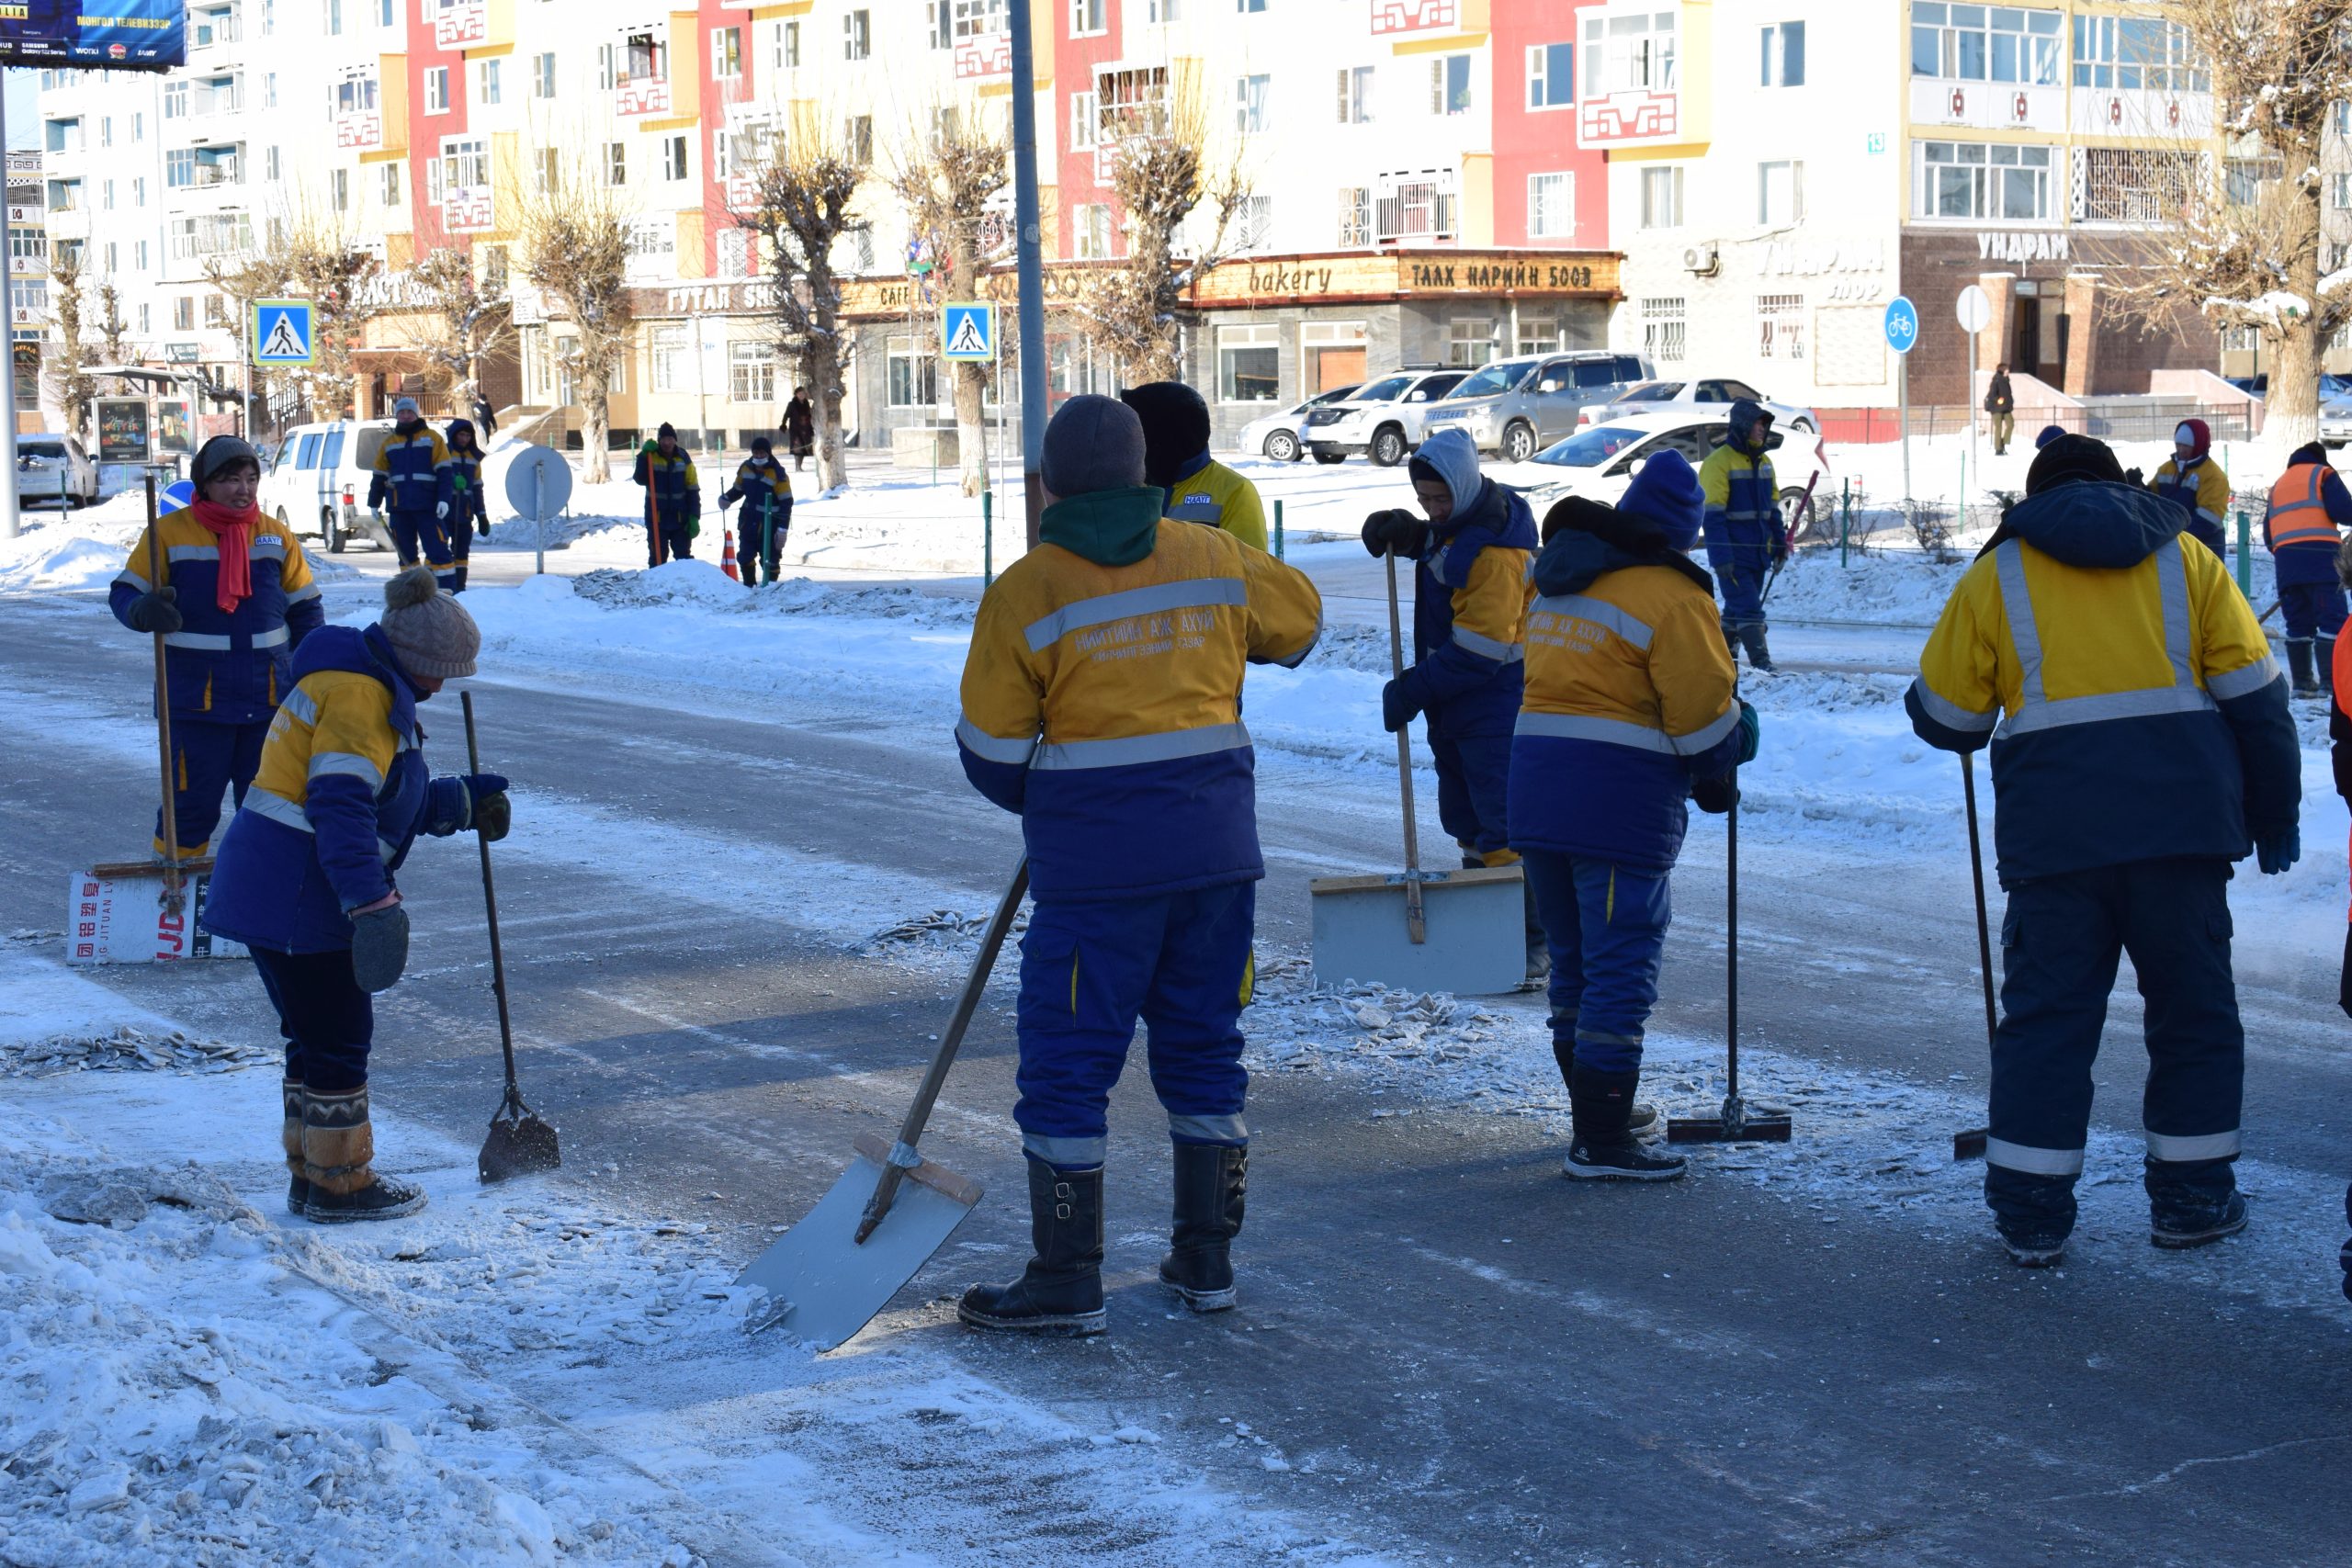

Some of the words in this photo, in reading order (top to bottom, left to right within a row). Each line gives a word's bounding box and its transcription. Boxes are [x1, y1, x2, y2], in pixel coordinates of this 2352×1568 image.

[77, 16, 114, 28] МОНГОЛ
[1869, 133, 1883, 152] 13
[1977, 232, 2069, 262] УНДРАМ
[1249, 263, 1331, 294] bakery
[1412, 265, 1454, 287] ТАЛХ
[1468, 261, 1539, 287] НАРИЙН
[1549, 265, 1591, 288] БООВ
[668, 286, 729, 312] ГУТАЛ
[1150, 616, 1174, 638] АЖ
[1181, 610, 1215, 633] АХУЙ
[100, 900, 112, 940] JITUAN
